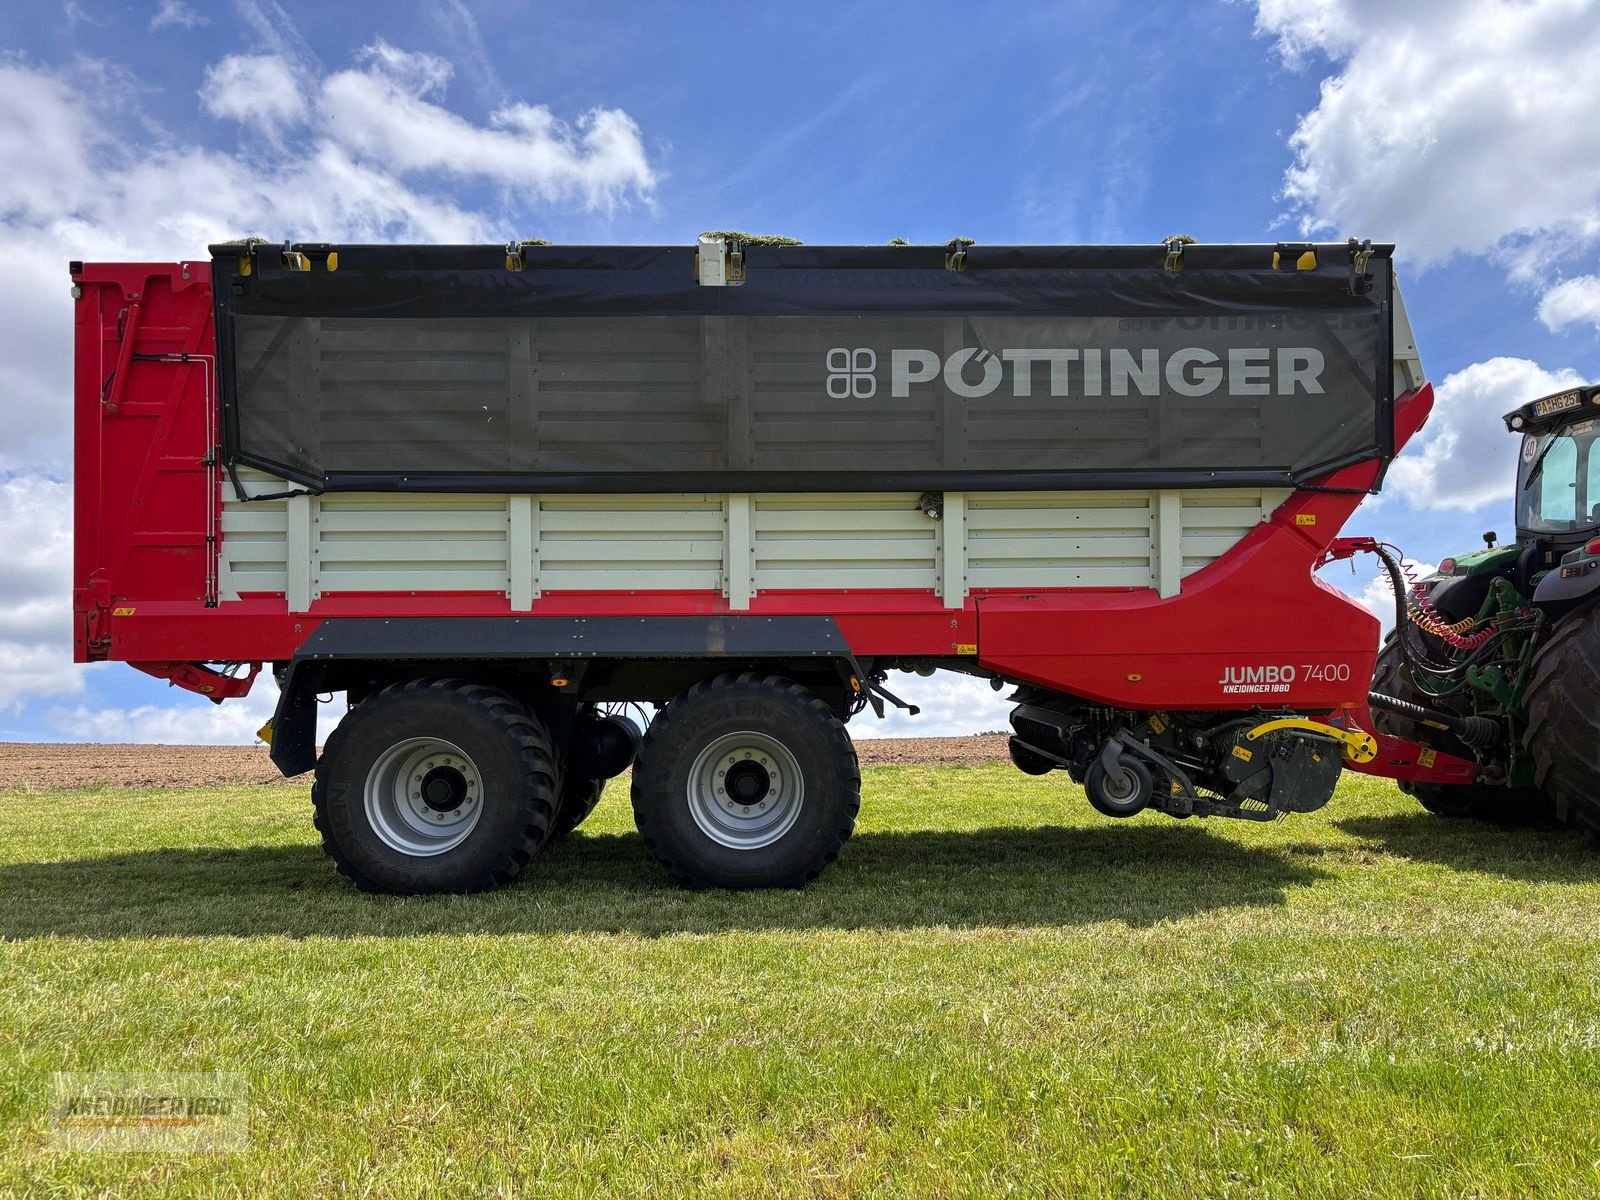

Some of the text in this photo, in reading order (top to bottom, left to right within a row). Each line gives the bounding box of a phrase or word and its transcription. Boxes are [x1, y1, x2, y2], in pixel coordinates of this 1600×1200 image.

[891, 347, 1326, 398] PÖTTINGER
[1536, 401, 1548, 415] PA
[1551, 397, 1564, 411] HG
[1524, 440, 1535, 458] 40
[1218, 663, 1350, 685] JUMBO 7400
[1223, 684, 1290, 694] KNEIDINGER 1880
